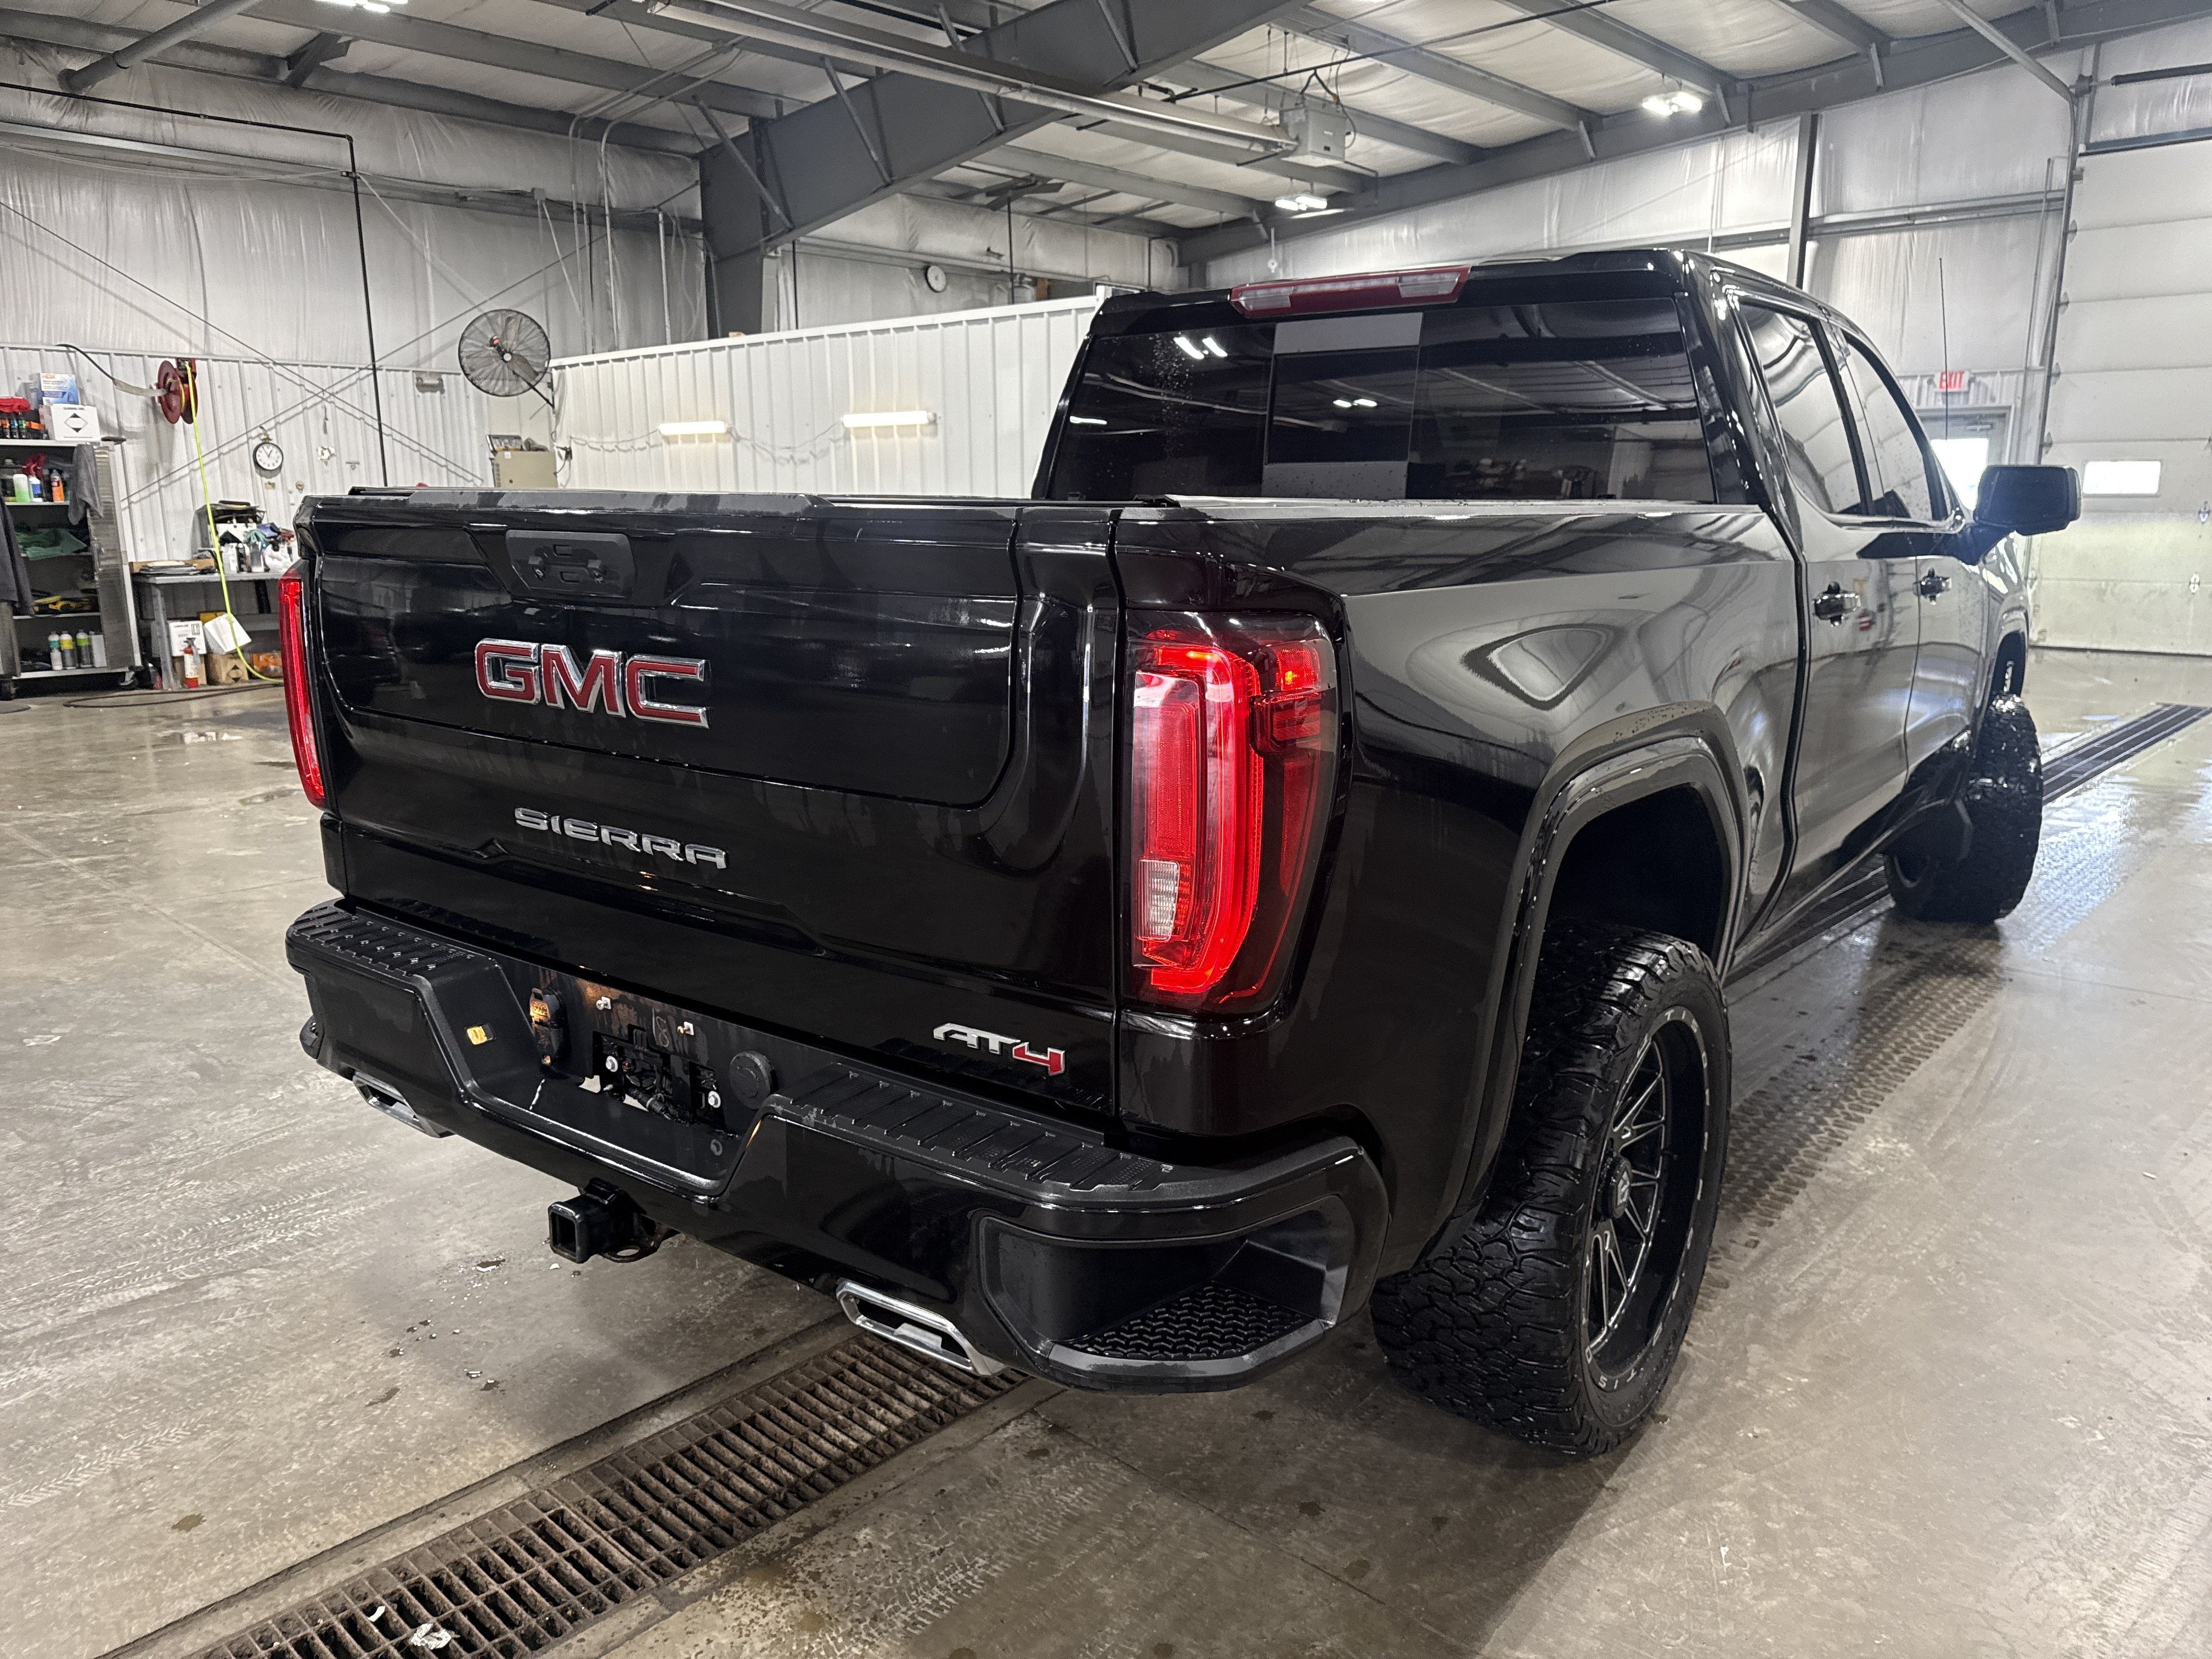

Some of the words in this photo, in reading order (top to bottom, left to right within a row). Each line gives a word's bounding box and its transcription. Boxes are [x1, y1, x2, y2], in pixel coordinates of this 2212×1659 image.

[1939, 370, 1965, 392] EXIT
[475, 637, 710, 729] GMC
[515, 807, 727, 869] SIERRA
[933, 1023, 1065, 1076] AT4
